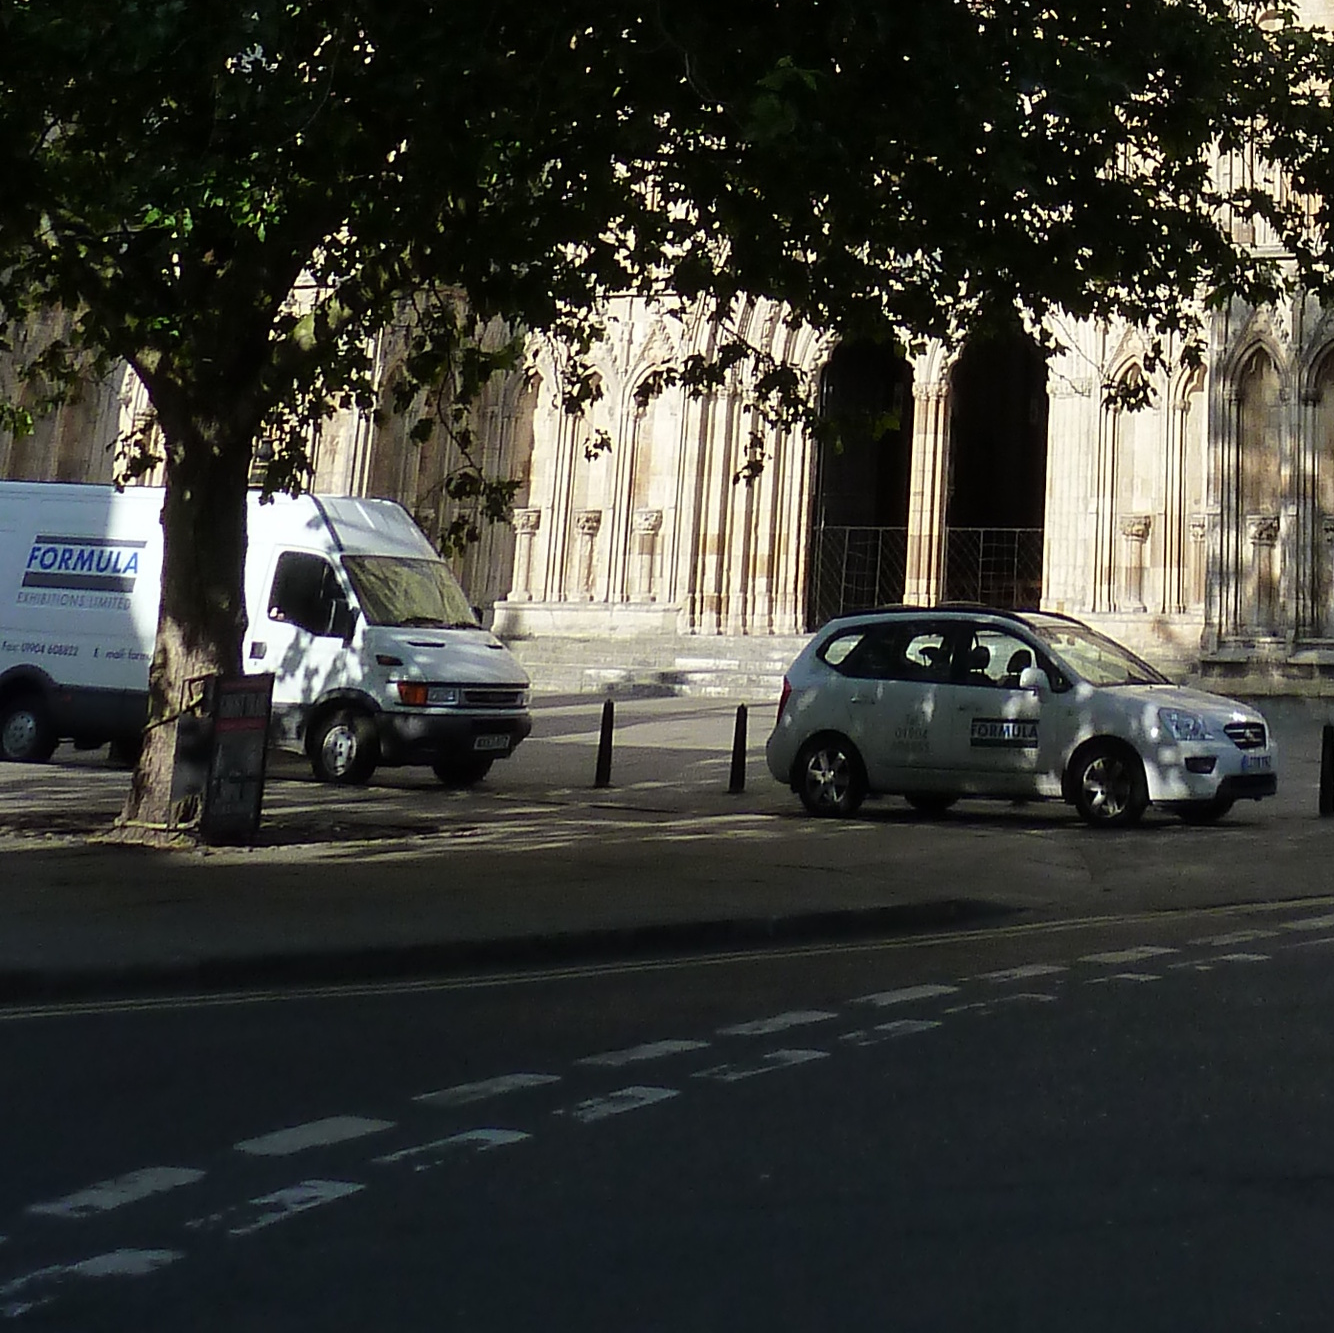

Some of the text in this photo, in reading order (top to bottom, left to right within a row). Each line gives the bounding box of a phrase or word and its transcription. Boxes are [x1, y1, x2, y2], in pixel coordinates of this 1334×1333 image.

[26, 546, 138, 574] FORMULA
[16, 592, 131, 610] EXHIBITIONS LIMITED
[971, 723, 1038, 739] FORMULA
